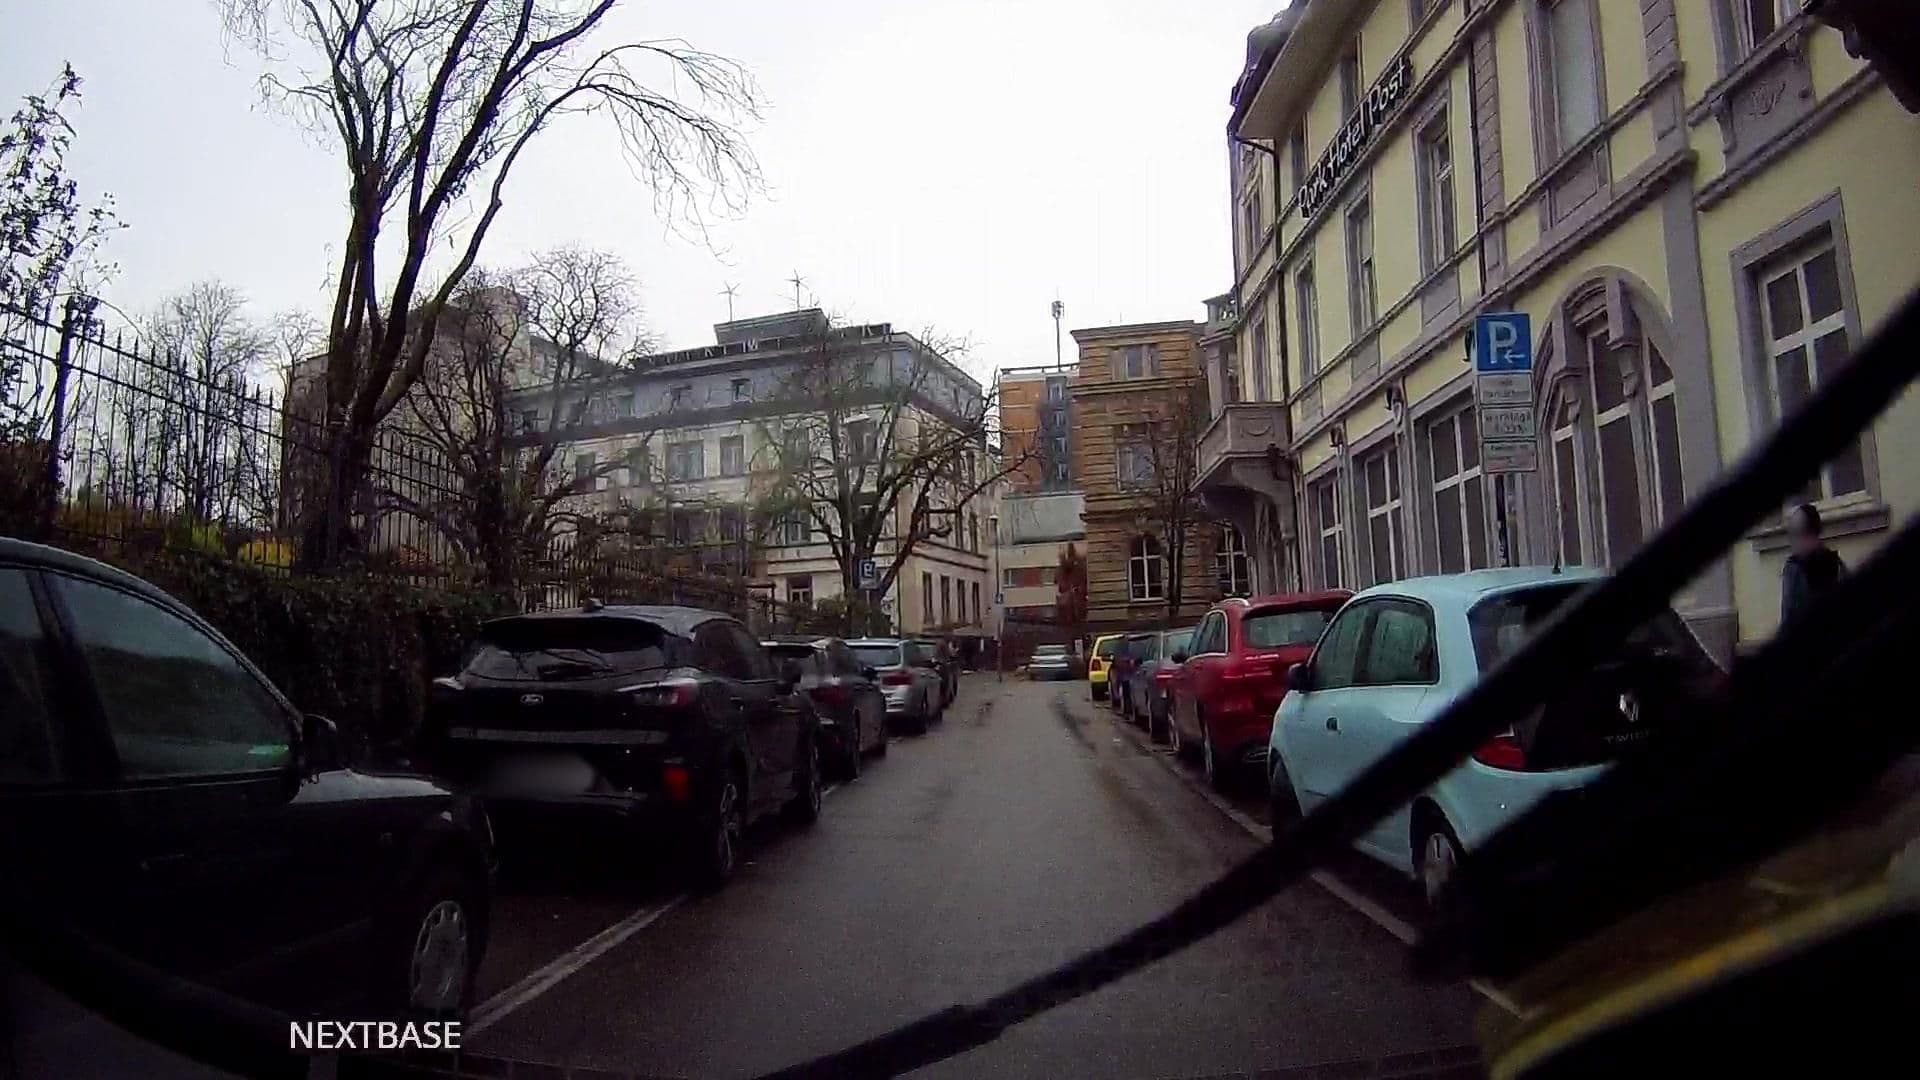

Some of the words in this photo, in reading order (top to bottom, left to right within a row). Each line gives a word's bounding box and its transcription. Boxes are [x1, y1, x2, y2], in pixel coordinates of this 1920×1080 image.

[1297, 162, 1329, 211] Park
[1328, 104, 1367, 178] Hotel
[1368, 57, 1408, 126] Post
[1486, 320, 1518, 365] P
